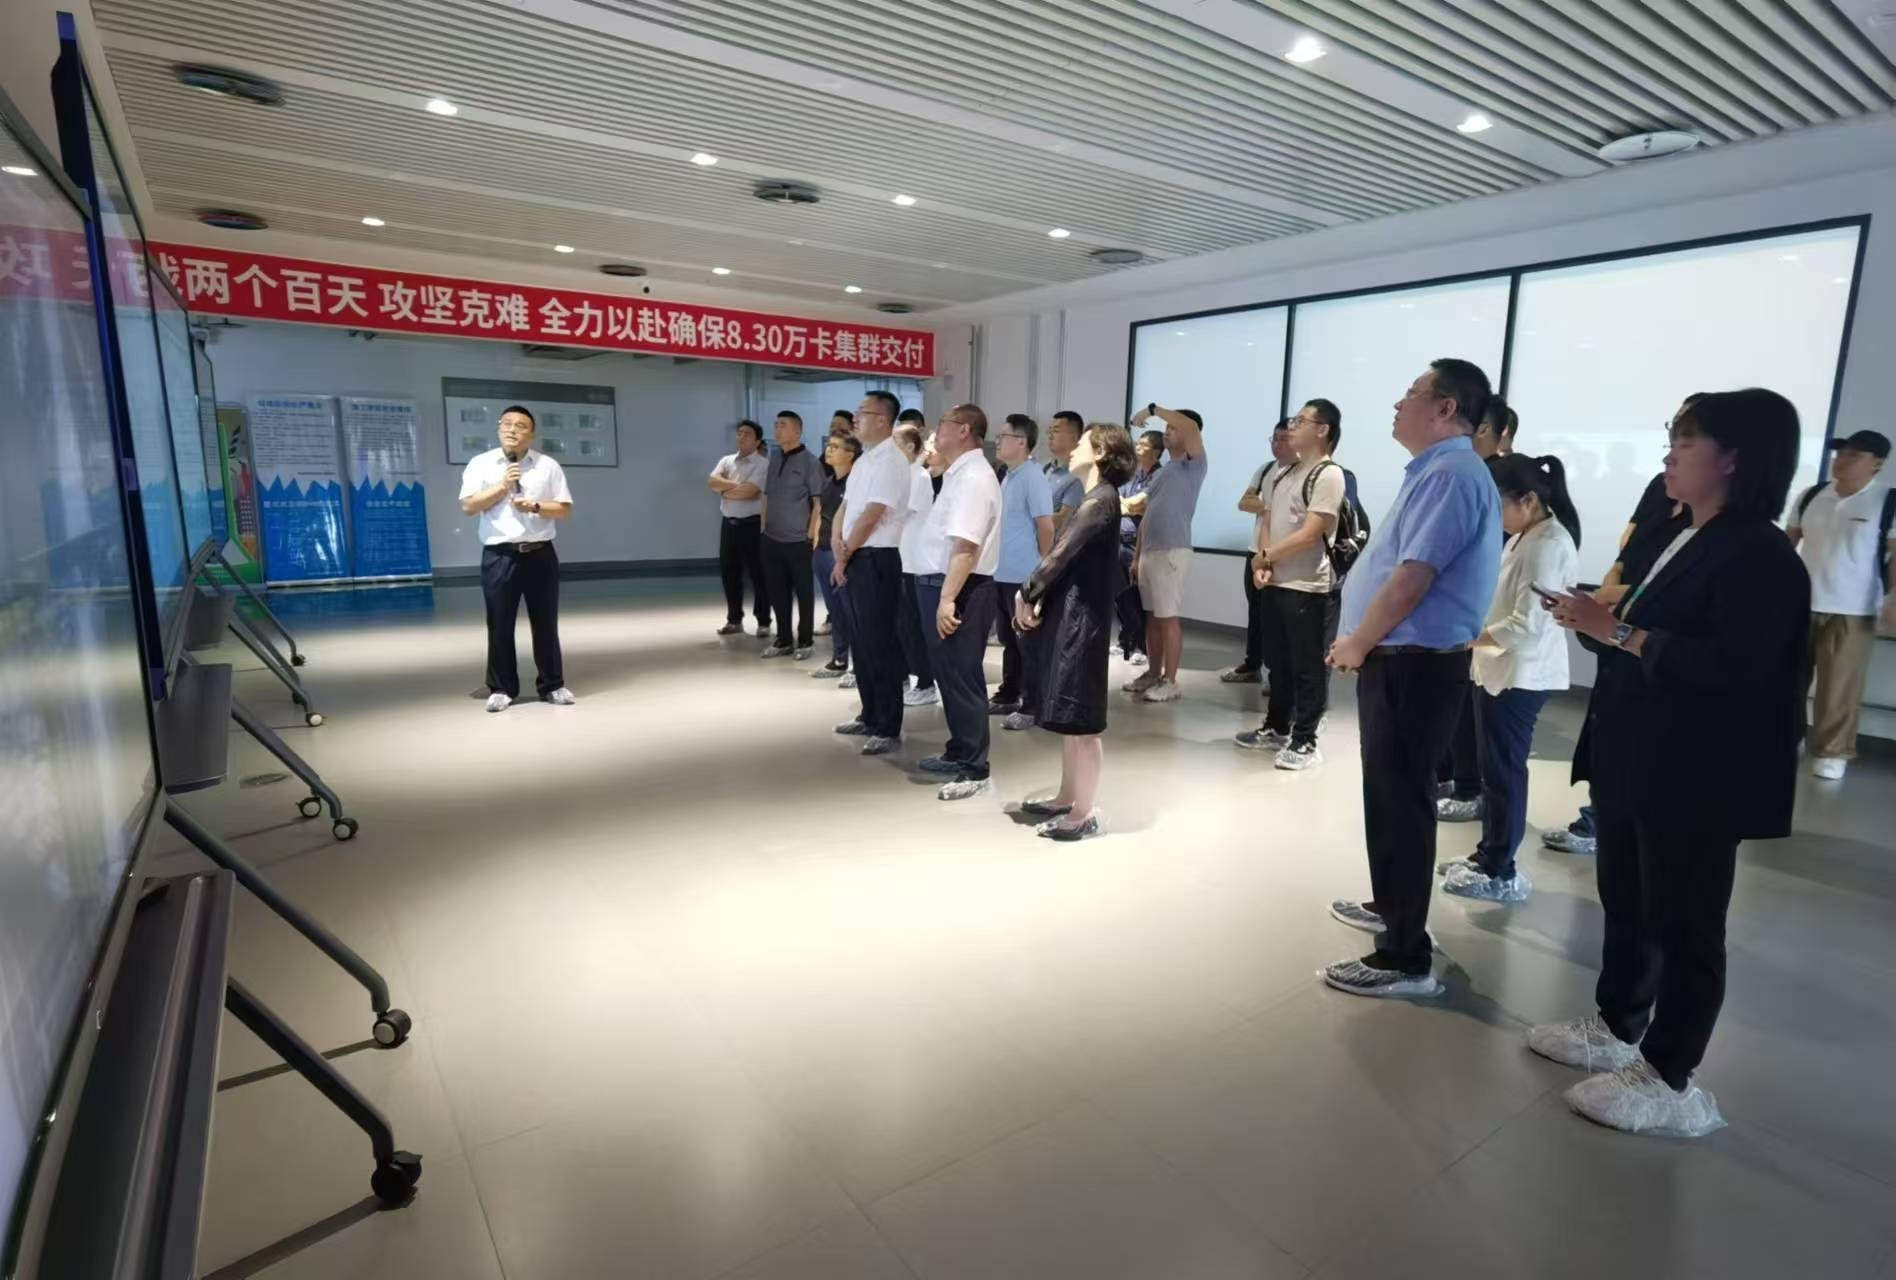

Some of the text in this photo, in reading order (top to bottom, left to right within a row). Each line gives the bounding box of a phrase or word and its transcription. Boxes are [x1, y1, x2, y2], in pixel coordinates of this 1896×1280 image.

[378, 281, 531, 333] 攻坚克难
[538, 297, 925, 369] 全力以赴确保8.30万卡集群交付
